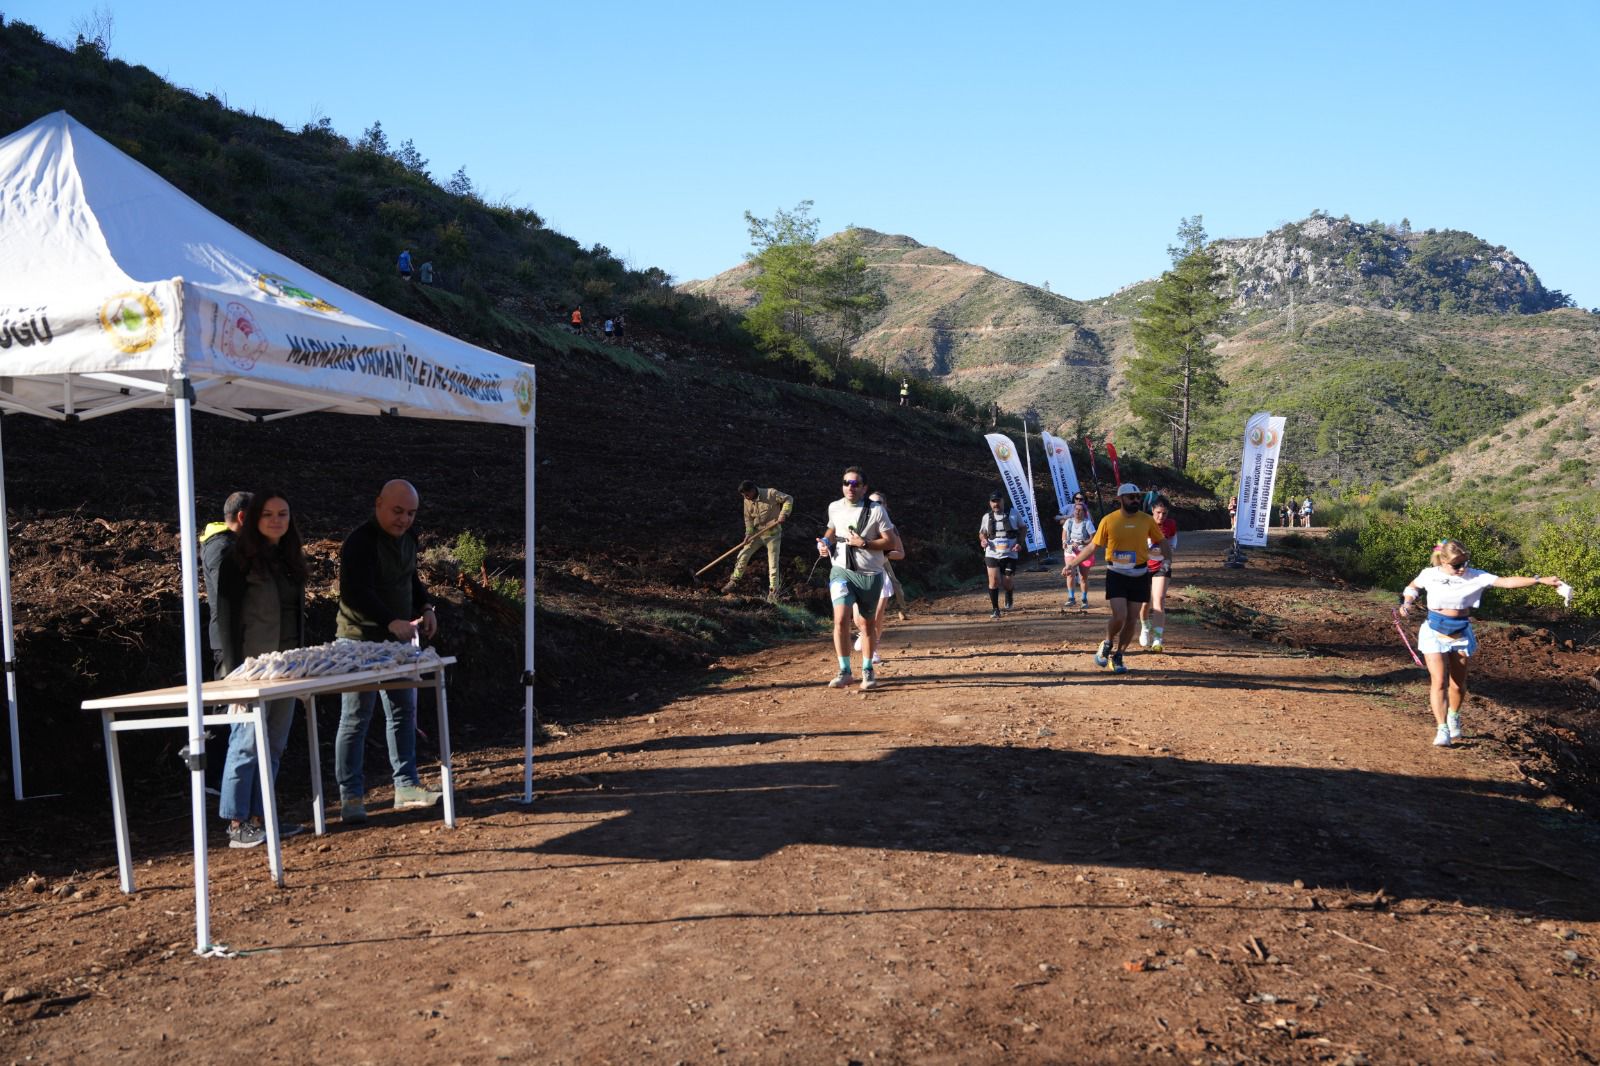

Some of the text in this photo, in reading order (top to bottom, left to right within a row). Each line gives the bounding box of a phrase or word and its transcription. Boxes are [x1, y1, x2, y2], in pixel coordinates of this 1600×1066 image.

[286, 333, 358, 372] MARMARİS
[357, 346, 402, 381] ORMAN
[403, 344, 447, 391] İŞLETME
[1256, 458, 1275, 539] BÖLGE MÜDÜRLÜĞÜ
